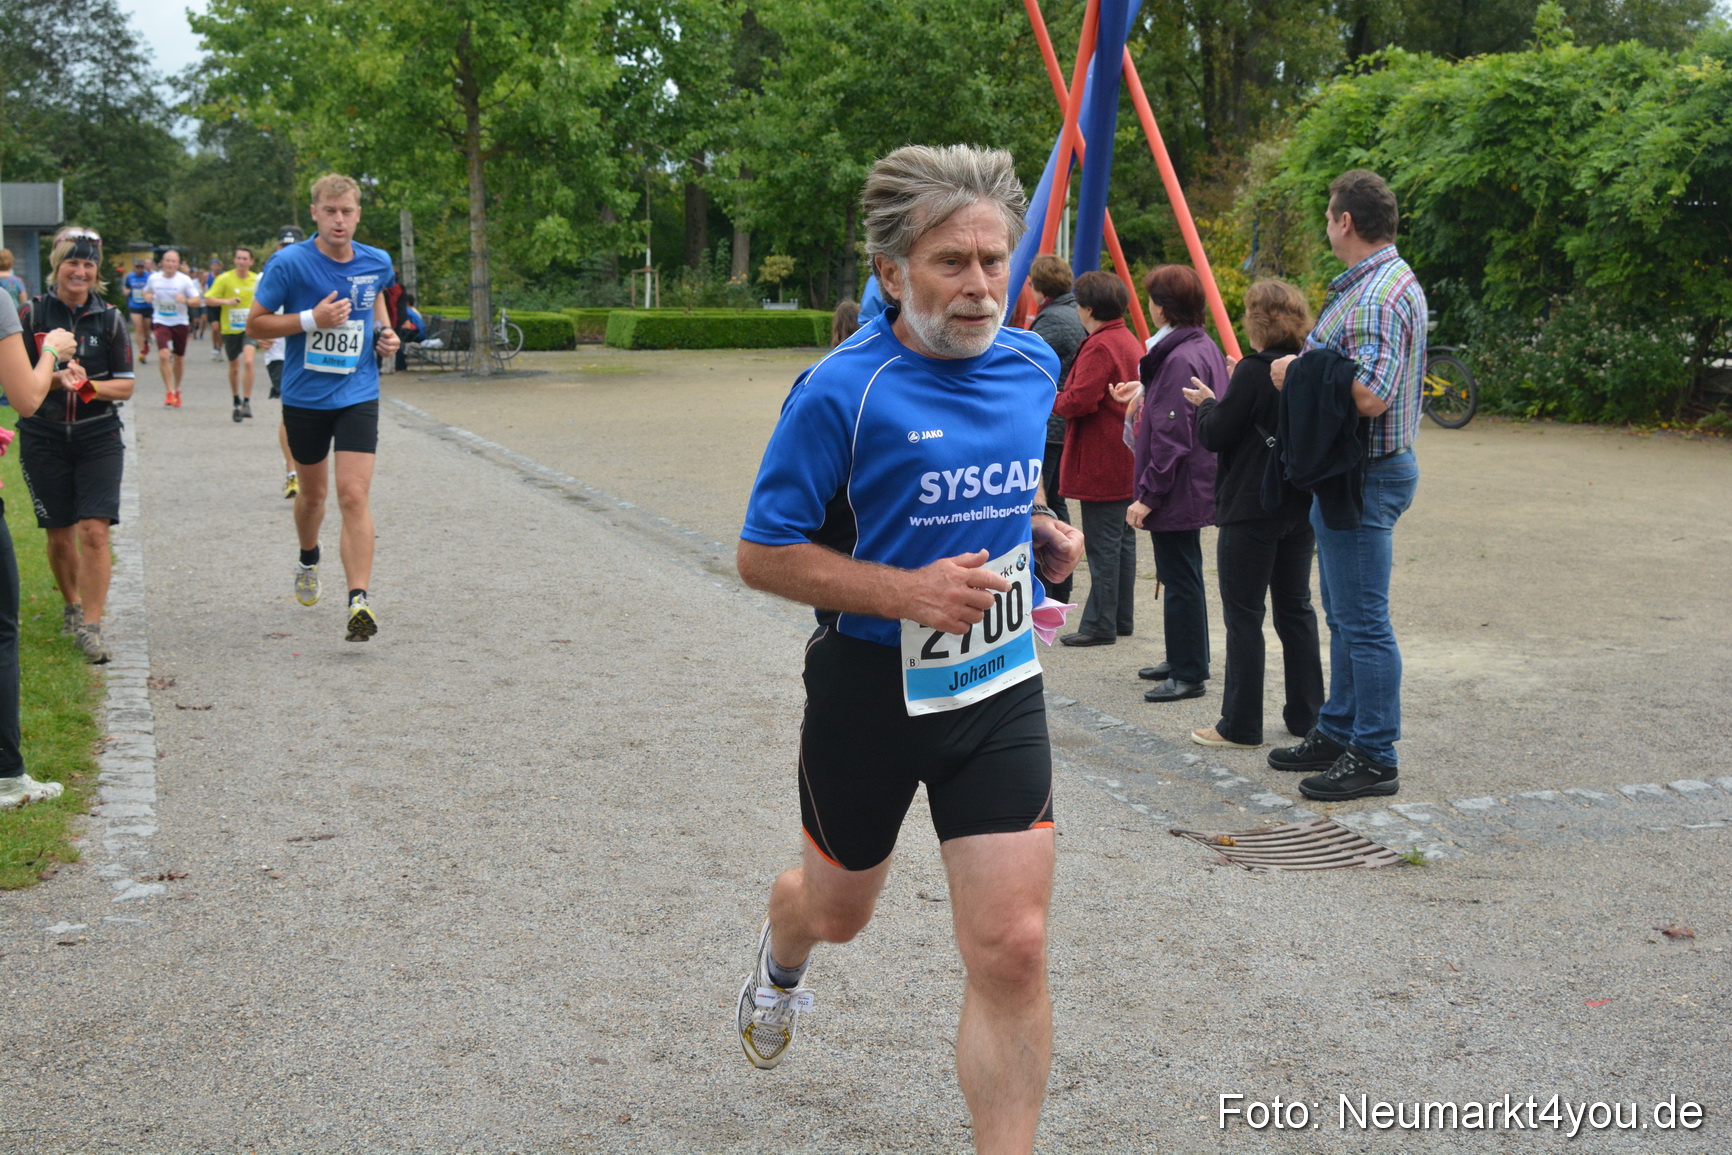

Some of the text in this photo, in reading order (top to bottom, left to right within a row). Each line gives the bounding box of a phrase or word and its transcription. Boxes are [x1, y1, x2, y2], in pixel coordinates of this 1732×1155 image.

[312, 331, 358, 353] 2084
[322, 357, 346, 366] Alfred
[921, 429, 944, 440] JAKO
[918, 458, 1042, 505] SYSCAD
[909, 658, 916, 668] B
[949, 654, 1005, 692] Johann
